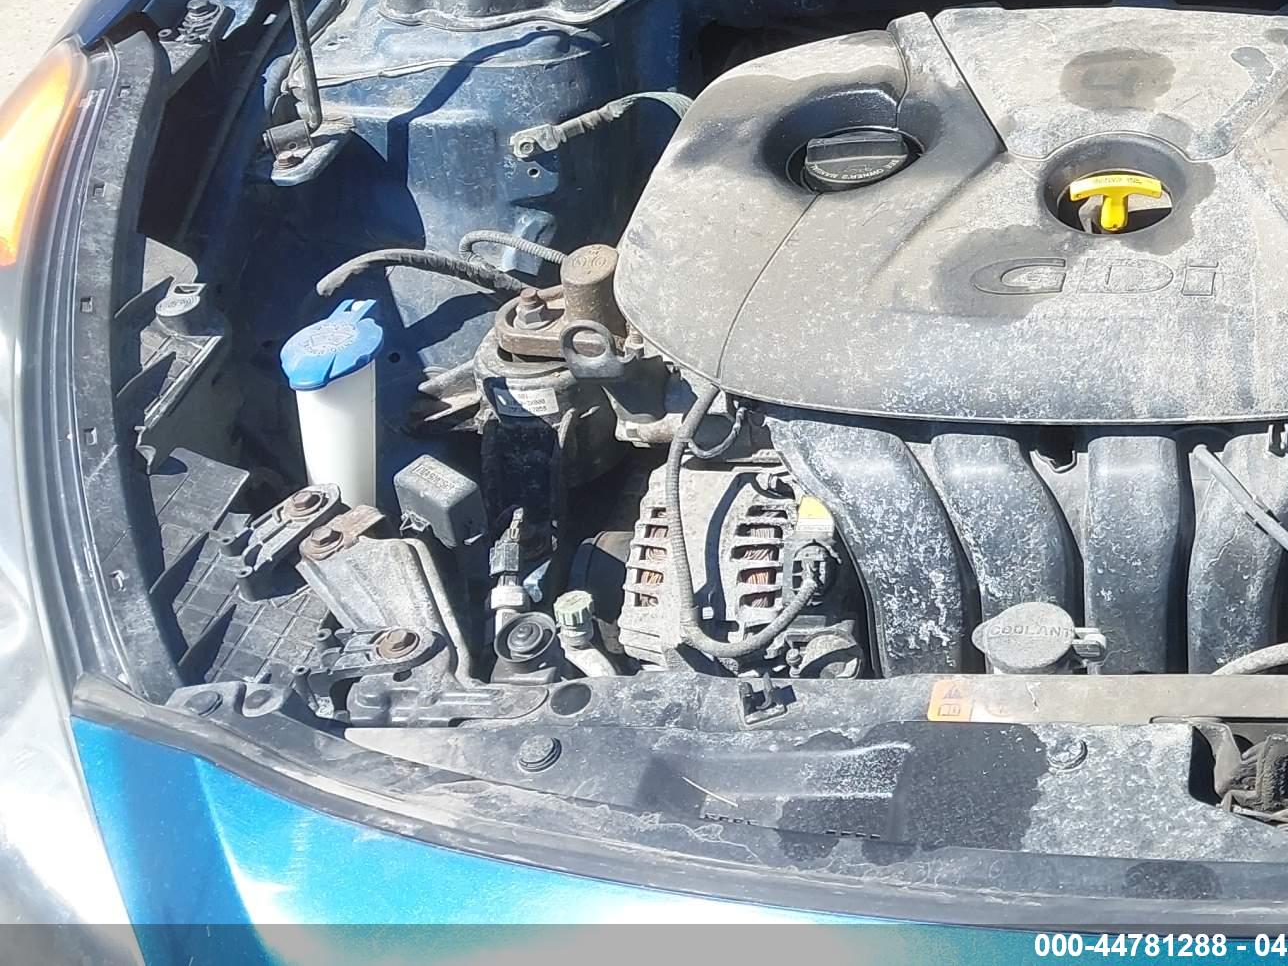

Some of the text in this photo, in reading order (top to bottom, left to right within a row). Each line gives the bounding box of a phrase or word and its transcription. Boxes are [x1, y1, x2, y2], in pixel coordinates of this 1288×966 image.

[841, 168, 885, 180] OWNER'S
[970, 257, 1220, 297] GDi
[989, 624, 1071, 638] COOLANT
